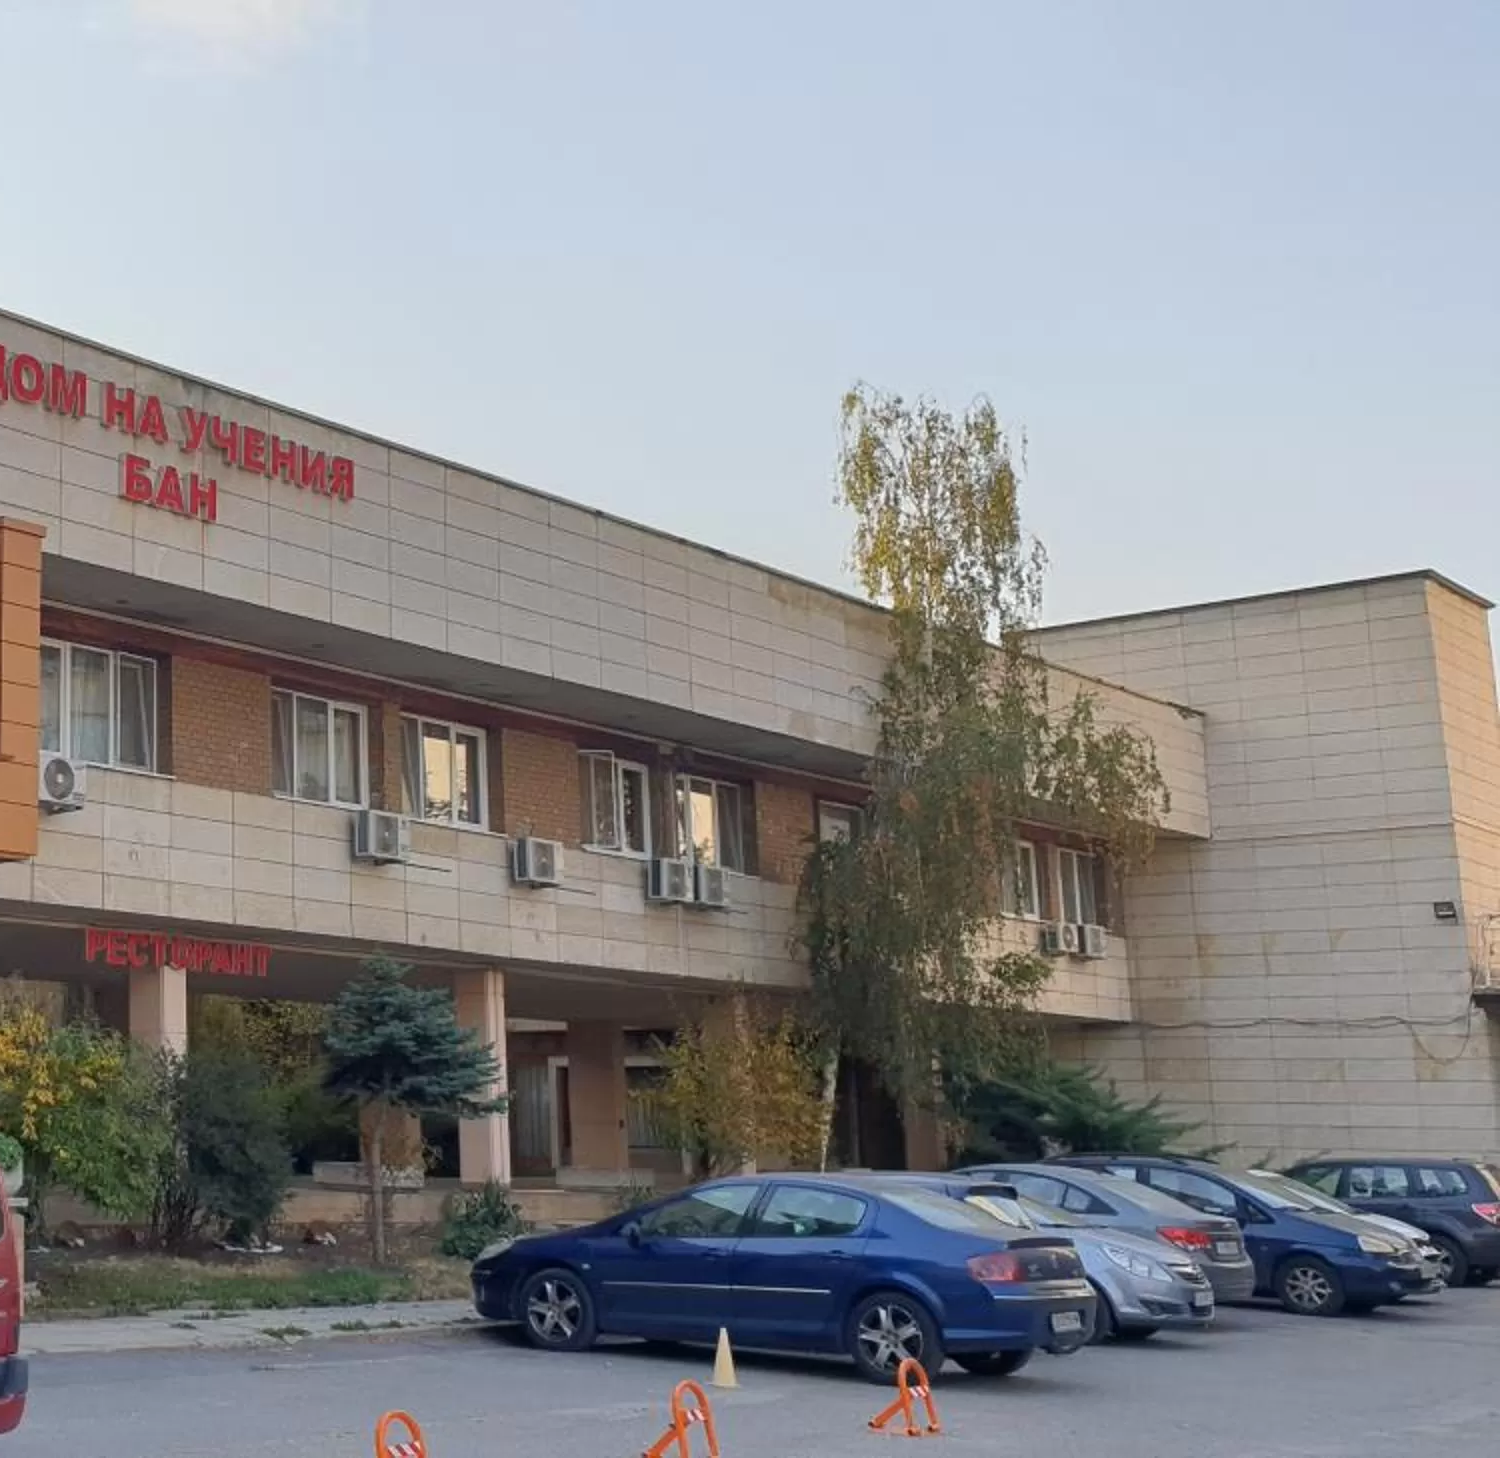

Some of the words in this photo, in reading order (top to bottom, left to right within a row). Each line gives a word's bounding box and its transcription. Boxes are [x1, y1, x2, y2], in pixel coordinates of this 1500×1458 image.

[103, 381, 168, 442] НА
[179, 406, 355, 500] УЧЕНИЯ
[119, 452, 217, 521] БАН
[84, 926, 273, 977] РЕСТОРАНТ
